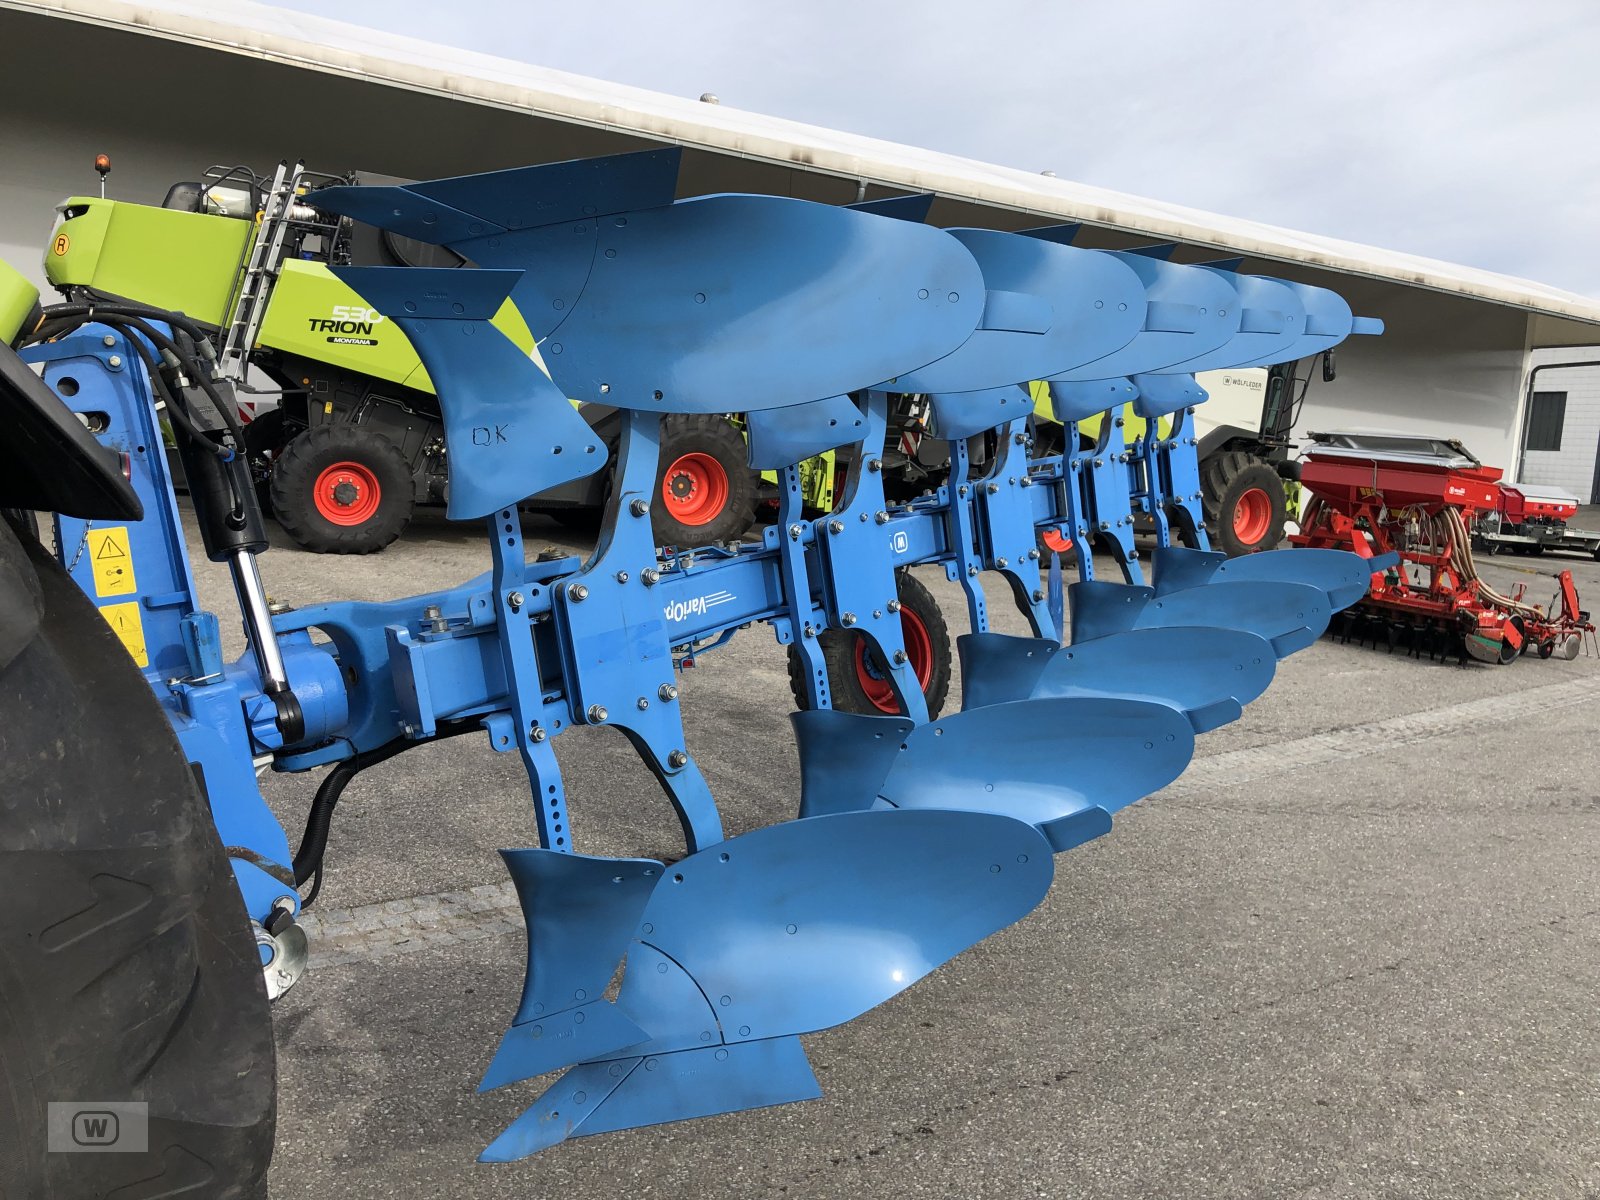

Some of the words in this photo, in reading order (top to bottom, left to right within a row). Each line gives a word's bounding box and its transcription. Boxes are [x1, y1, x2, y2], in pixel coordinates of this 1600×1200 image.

[57, 237, 66, 252] R
[331, 305, 385, 324] 530
[308, 318, 374, 335] TRION
[333, 337, 371, 345] MONTANA
[1232, 378, 1262, 389] WÖLFLEDER
[662, 563, 672, 571] 25
